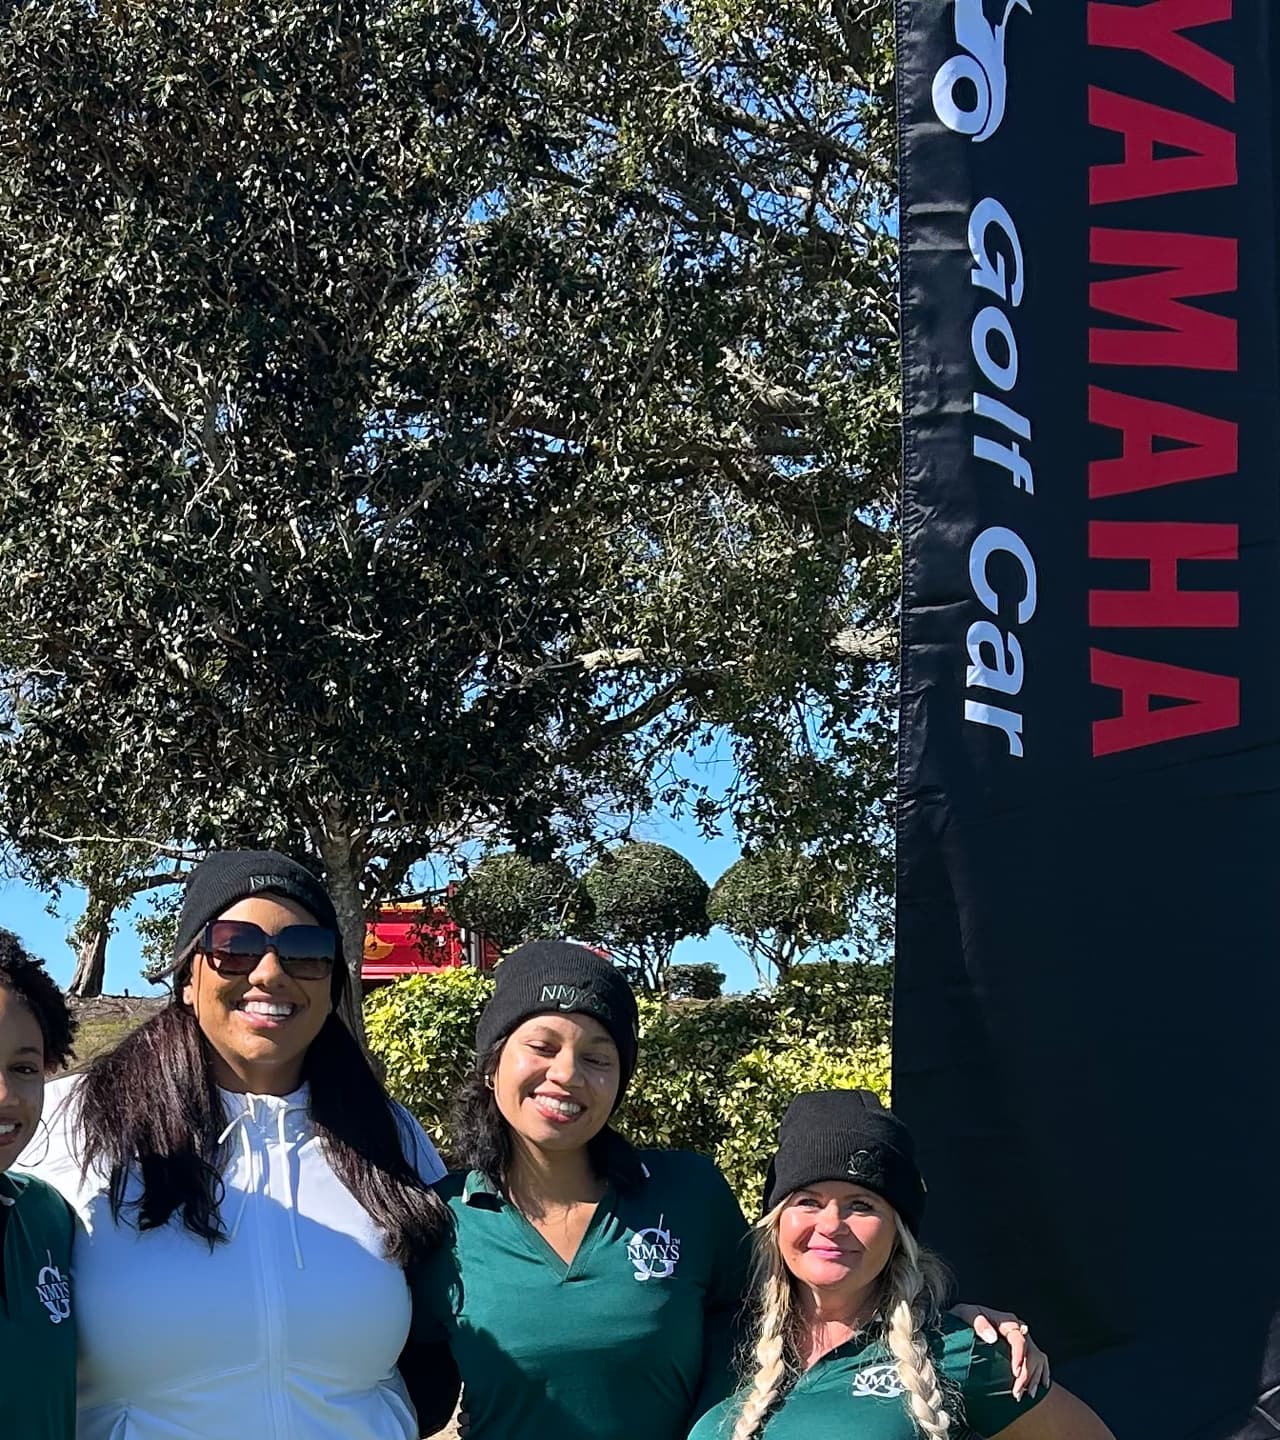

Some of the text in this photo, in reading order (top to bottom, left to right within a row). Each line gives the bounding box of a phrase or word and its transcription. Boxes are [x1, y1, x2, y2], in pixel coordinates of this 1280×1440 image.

[964, 197, 1038, 758] Golf Car
[1087, 0, 1240, 758] YAMAHA
[626, 1244, 680, 1261] NMYS
[852, 1373, 904, 1390] NMY
